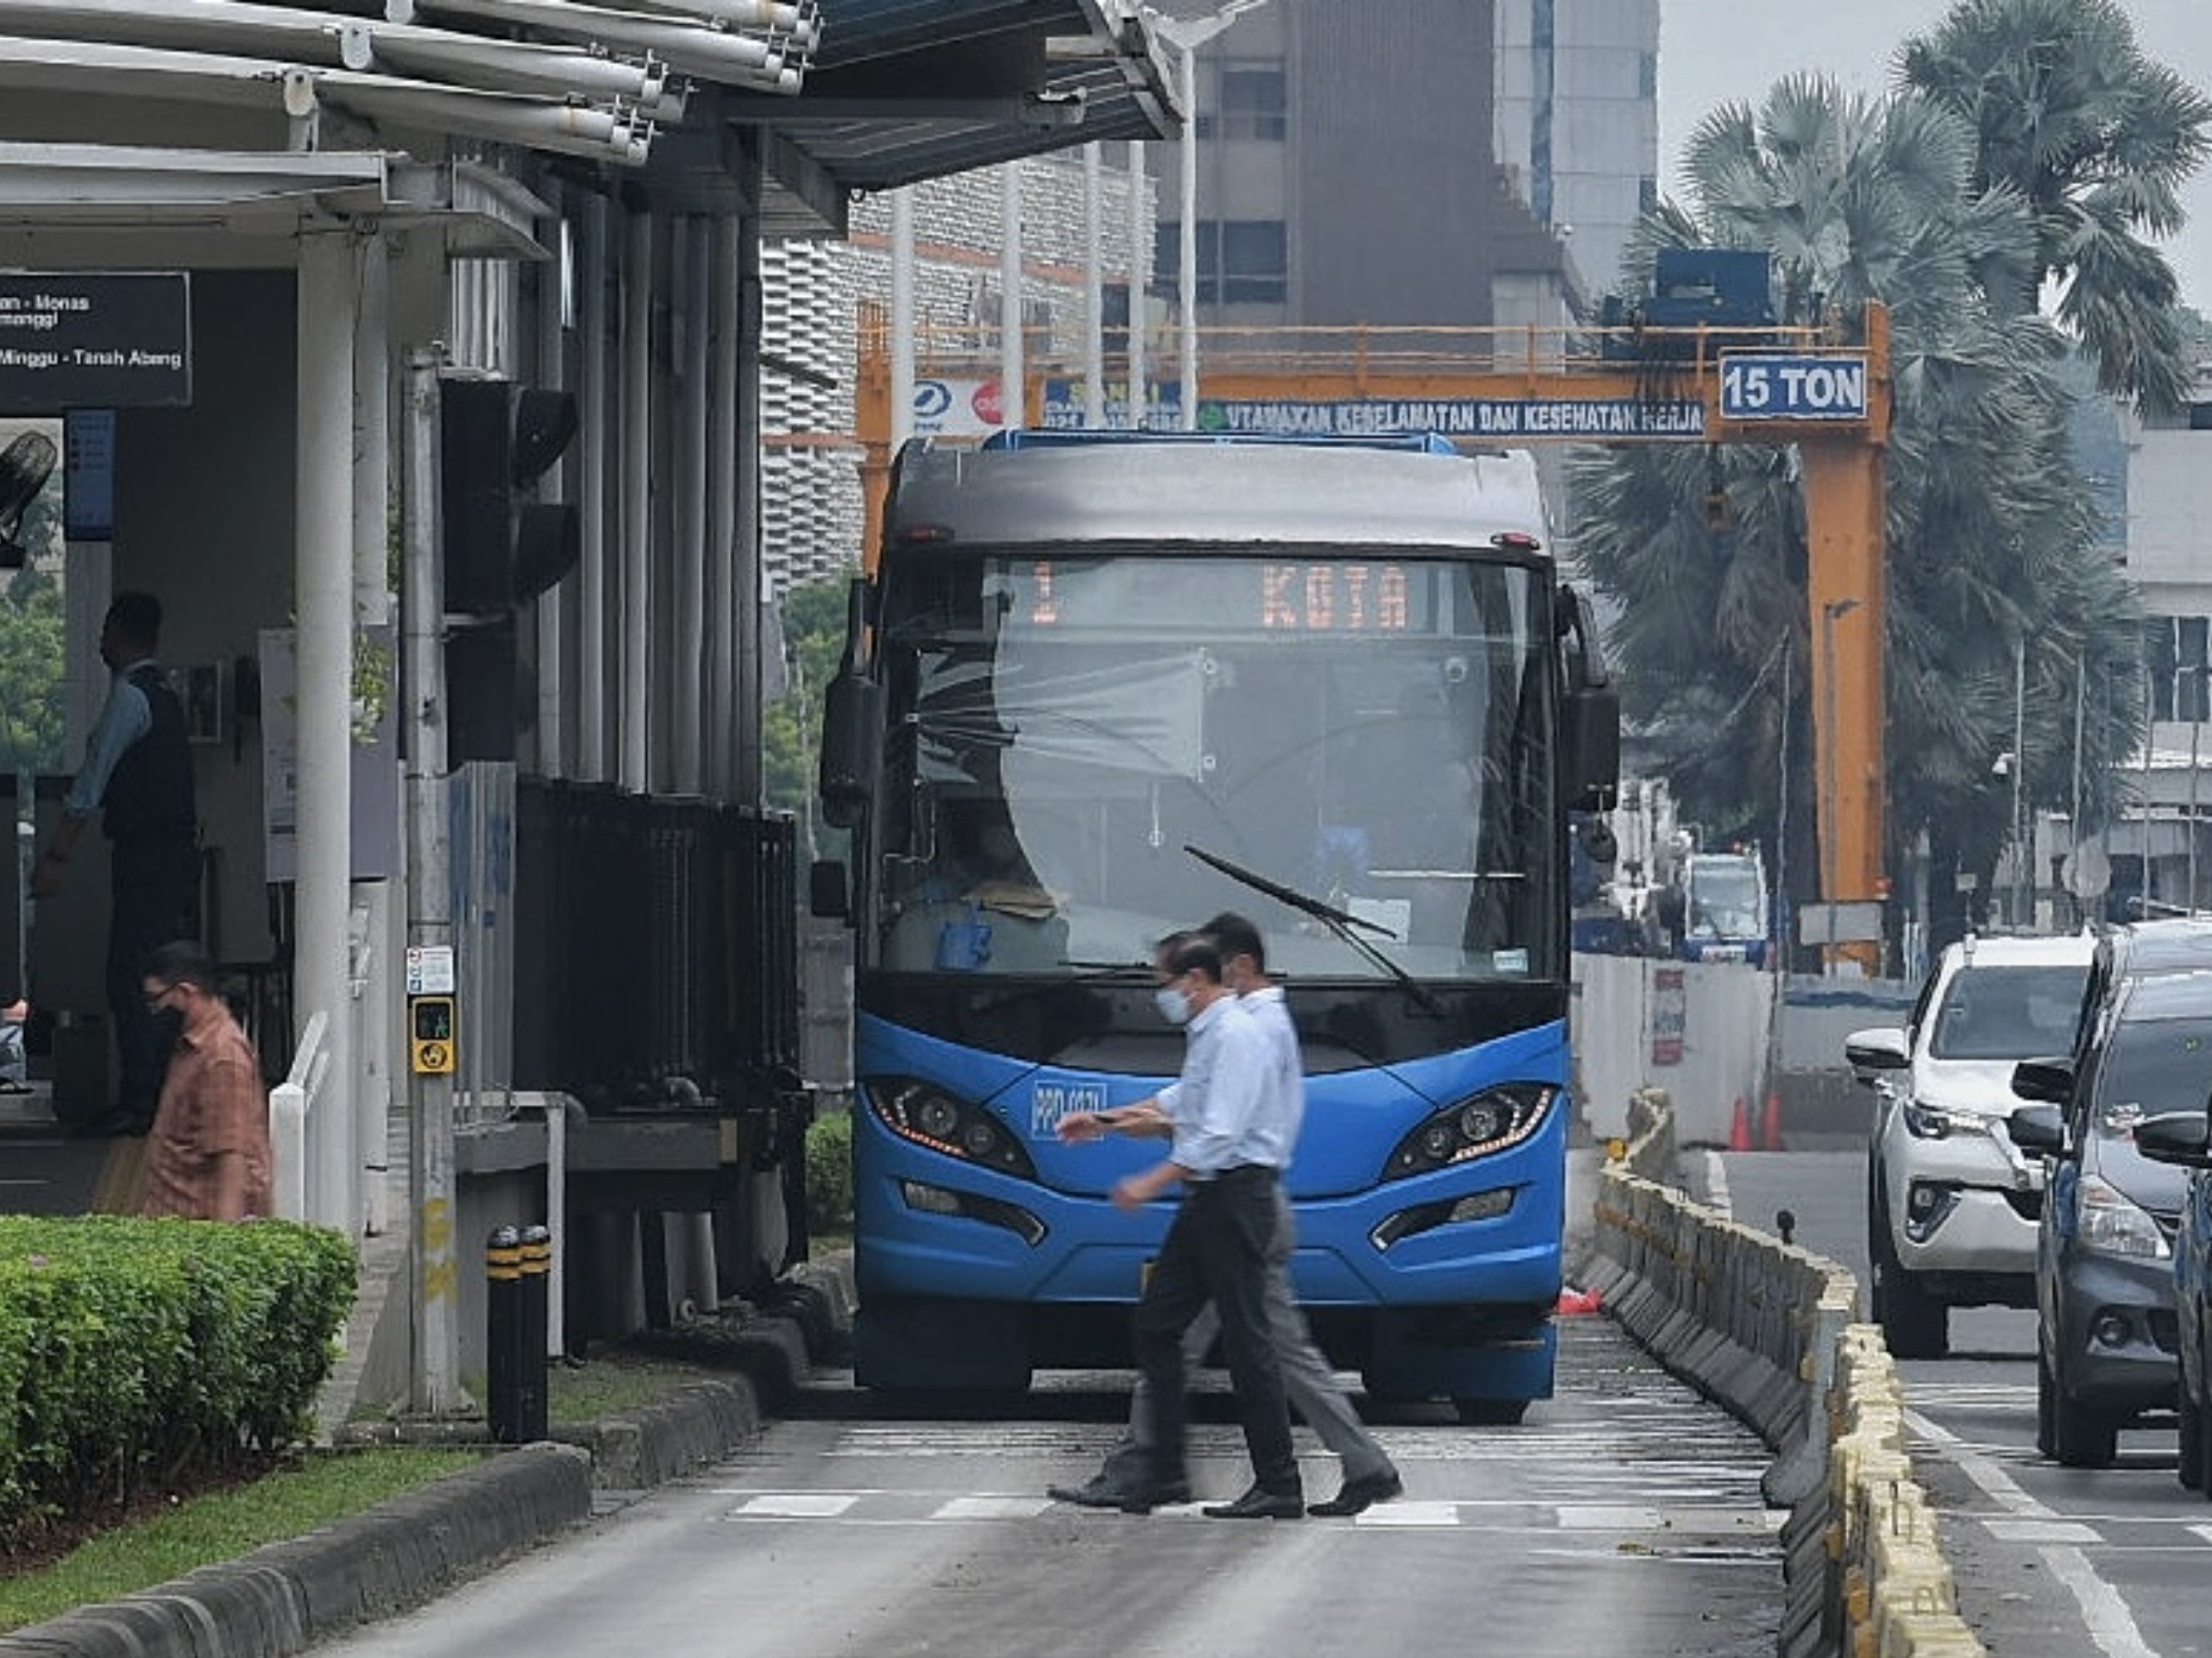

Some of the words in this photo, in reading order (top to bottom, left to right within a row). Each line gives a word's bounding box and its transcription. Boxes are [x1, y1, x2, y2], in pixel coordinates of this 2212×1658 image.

[35, 294, 90, 311] Monas
[74, 349, 124, 367] Tanah
[129, 349, 182, 370] Abang
[1724, 366, 1770, 408] 15
[1780, 366, 1862, 408] TON
[1336, 403, 1475, 431] KESELAMATAN
[1479, 404, 1517, 430] DAN
[1524, 404, 1636, 430] KESEHATAN
[1641, 405, 1702, 430] KERJA
[1033, 561, 1057, 624] 1
[1263, 565, 1406, 628] KOTA
